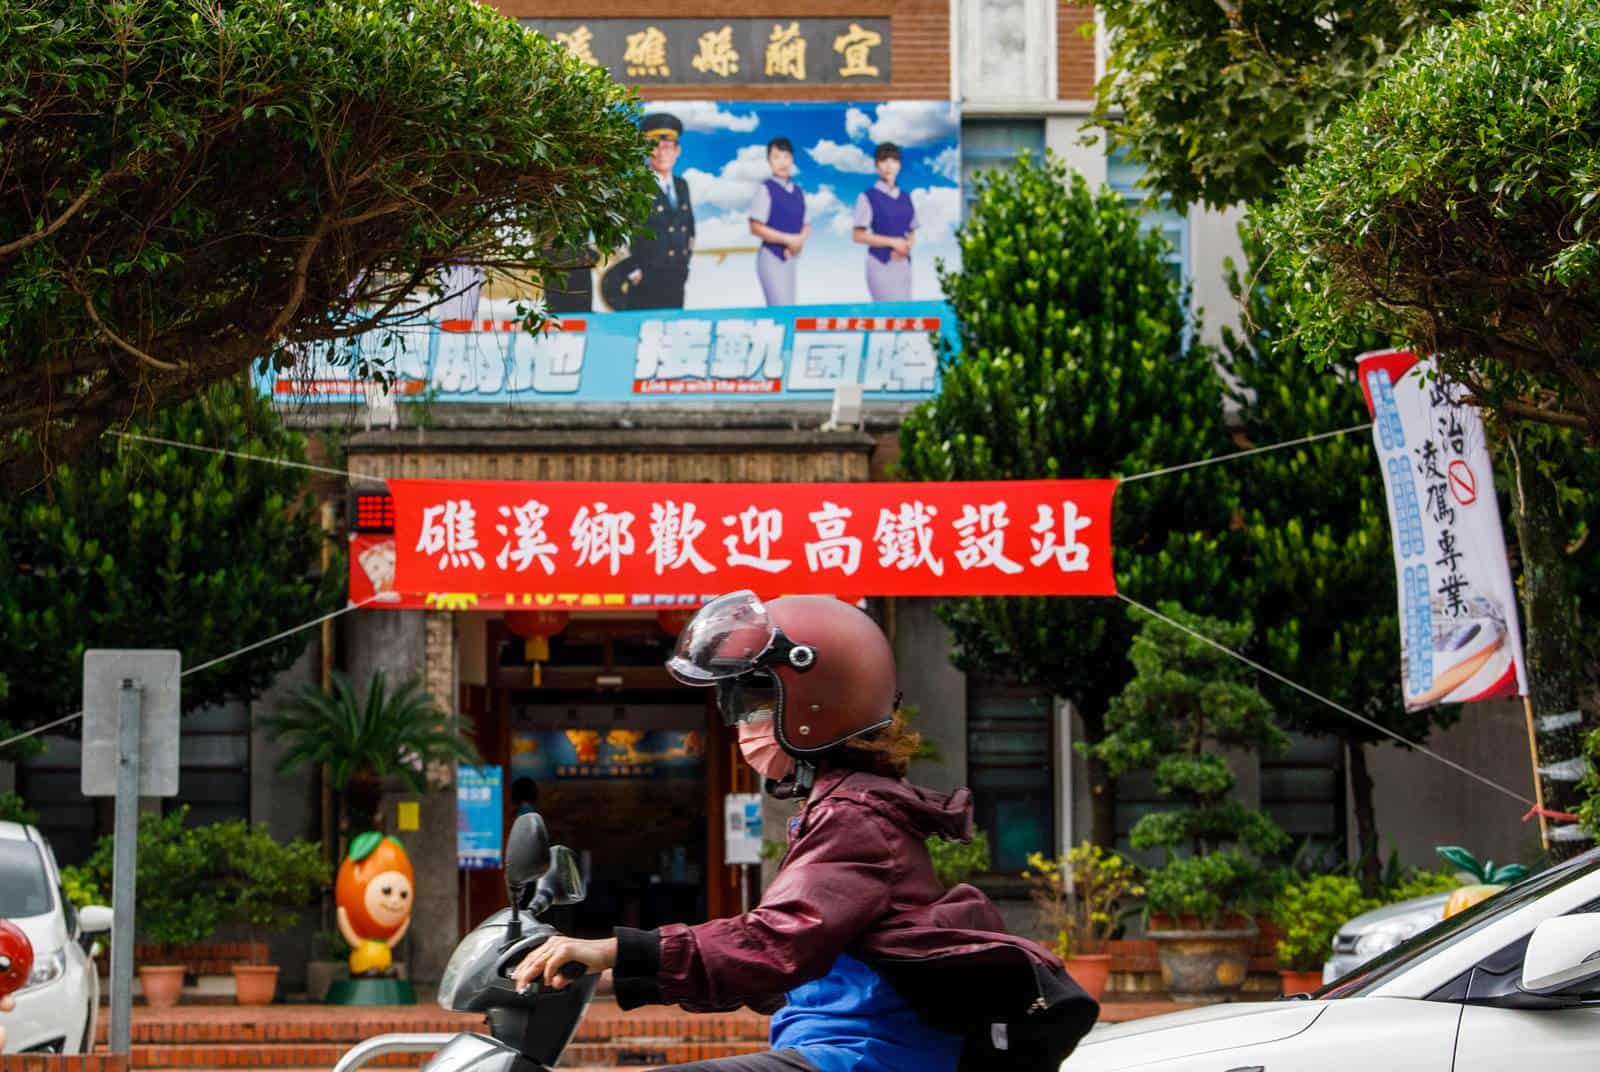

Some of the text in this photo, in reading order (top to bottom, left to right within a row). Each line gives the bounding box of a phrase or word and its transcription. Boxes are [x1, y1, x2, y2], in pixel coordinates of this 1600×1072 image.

[415, 499, 1093, 577] 礁溪鄉歡迎高鐵設站
